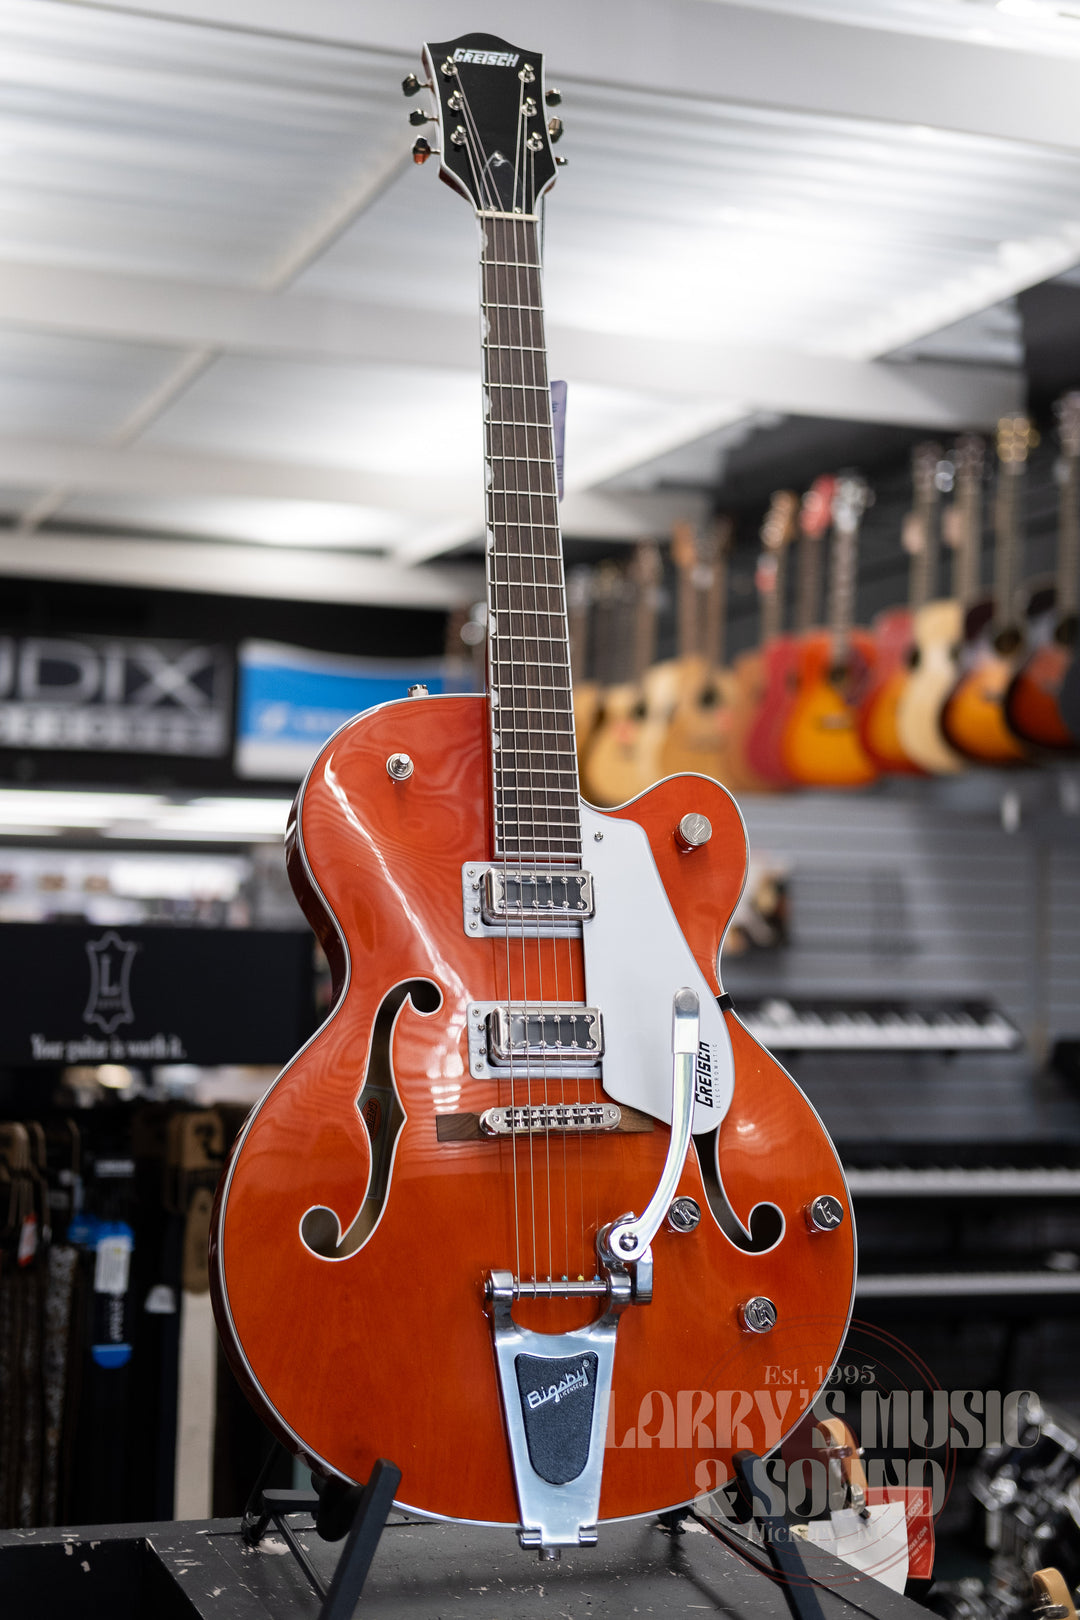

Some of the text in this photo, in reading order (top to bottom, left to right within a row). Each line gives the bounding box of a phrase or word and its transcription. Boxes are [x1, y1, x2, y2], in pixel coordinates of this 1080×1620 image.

[453, 48, 520, 68] GRETSCH
[0, 637, 216, 708] DIX
[712, 1044, 722, 1109] ELECTROMATIC
[526, 1366, 589, 1409] Bigsby
[560, 1381, 583, 1399] LICENSED
